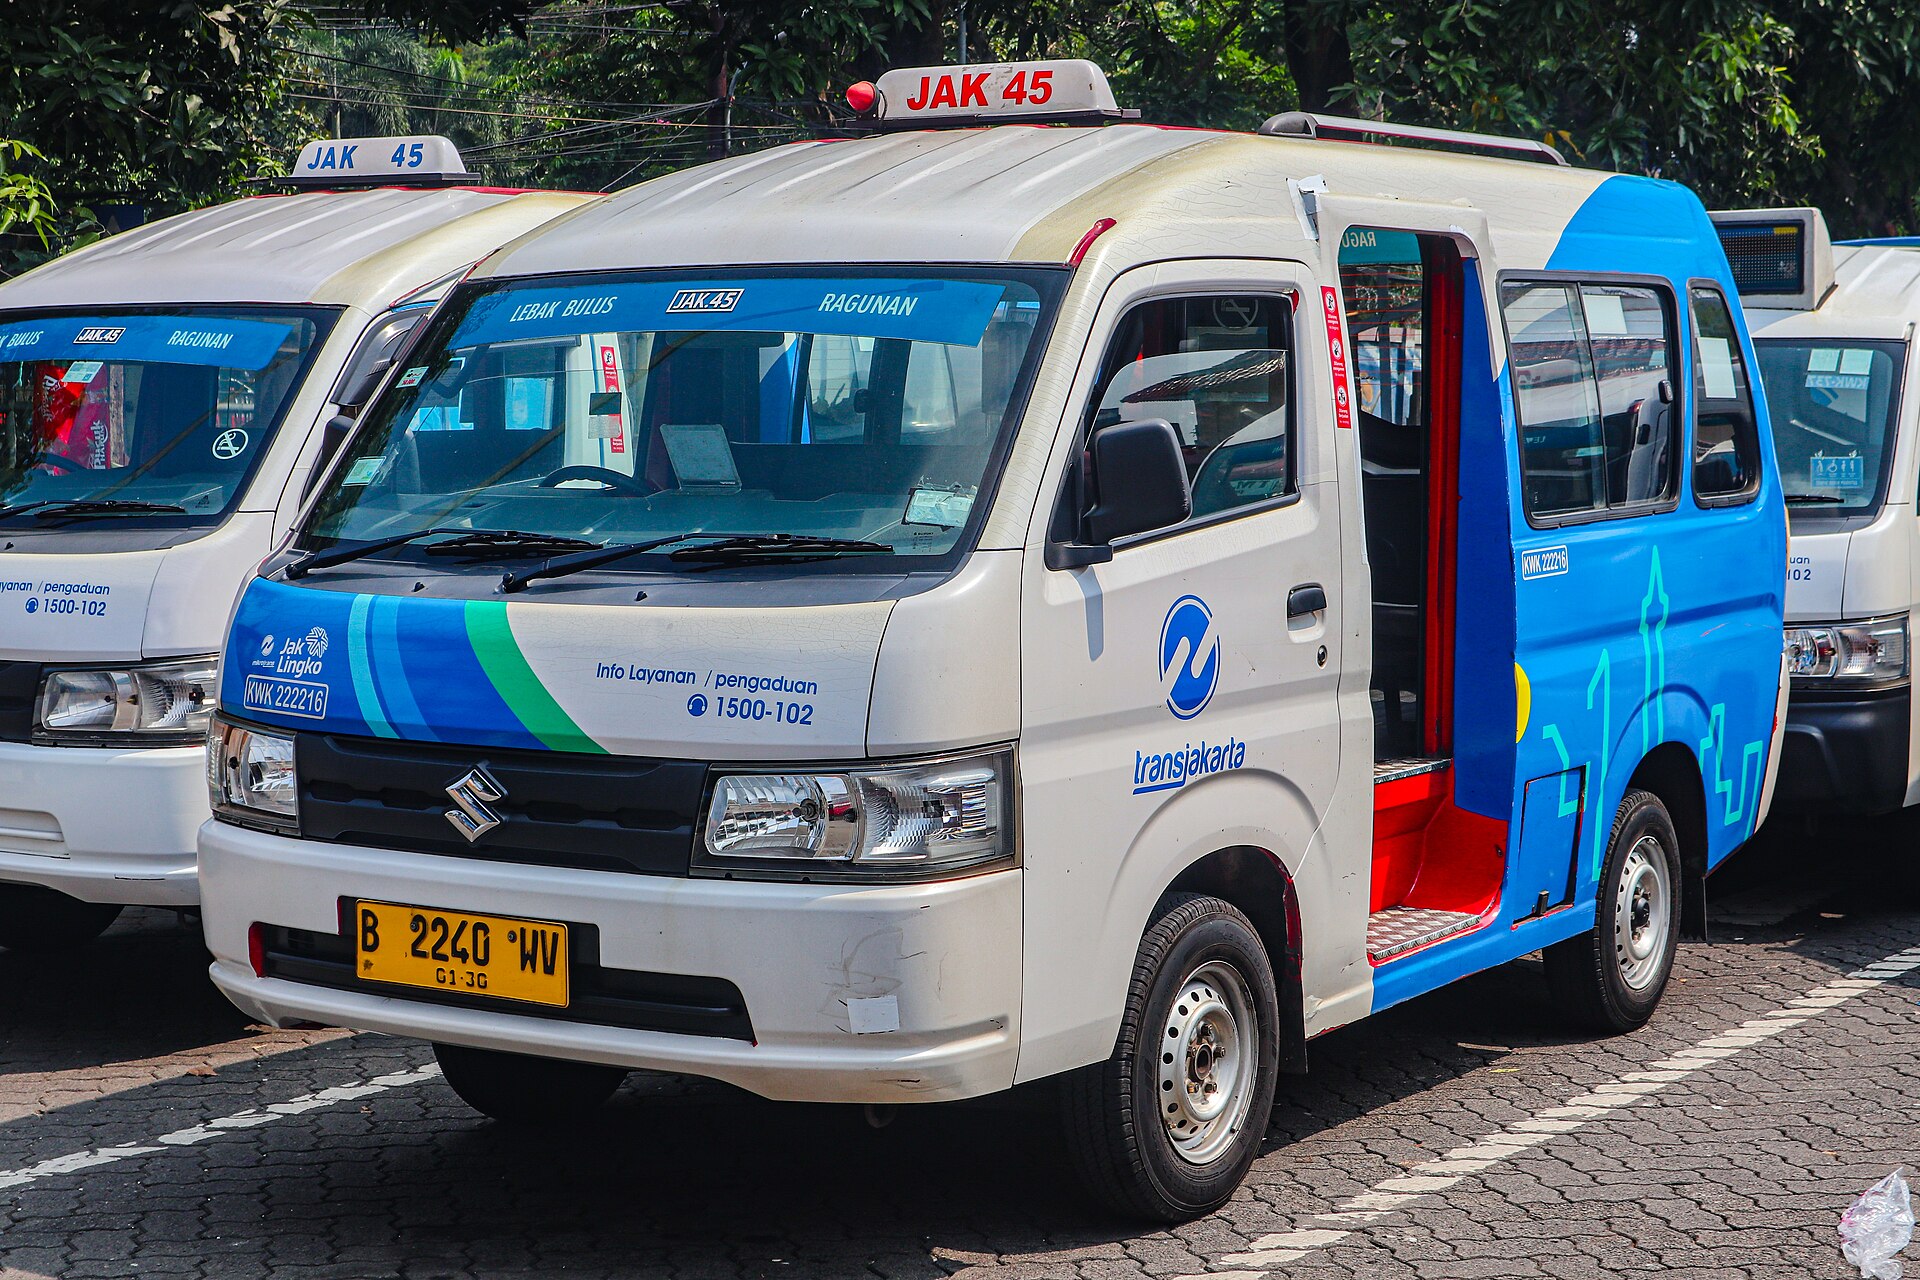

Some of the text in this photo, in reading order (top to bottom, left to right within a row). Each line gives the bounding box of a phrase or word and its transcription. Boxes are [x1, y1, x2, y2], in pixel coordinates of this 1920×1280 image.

[906, 70, 1054, 111] JAK 45
[307, 143, 424, 170] JAK 45
[509, 296, 618, 323] LEBAK BULUS
[672, 292, 738, 310] JAK.45
[817, 293, 919, 316] RAGUNAN
[6, 330, 44, 348] BULUS
[78, 329, 121, 342] JAK.45
[166, 330, 234, 350] RAGUNAN
[1523, 550, 1566, 575] KWK 222216
[0, 581, 33, 594] yanan
[44, 598, 107, 617] 1500-102
[279, 637, 305, 655] Jak
[276, 655, 323, 678] Lingko
[596, 662, 625, 680] Info
[628, 664, 697, 685] Layanan
[714, 672, 818, 695] pengaduan
[246, 680, 324, 713] KWK 222216
[716, 696, 814, 726] 1500-102
[1132, 736, 1246, 796] transjakarta
[361, 908, 559, 976] B 2240 WV
